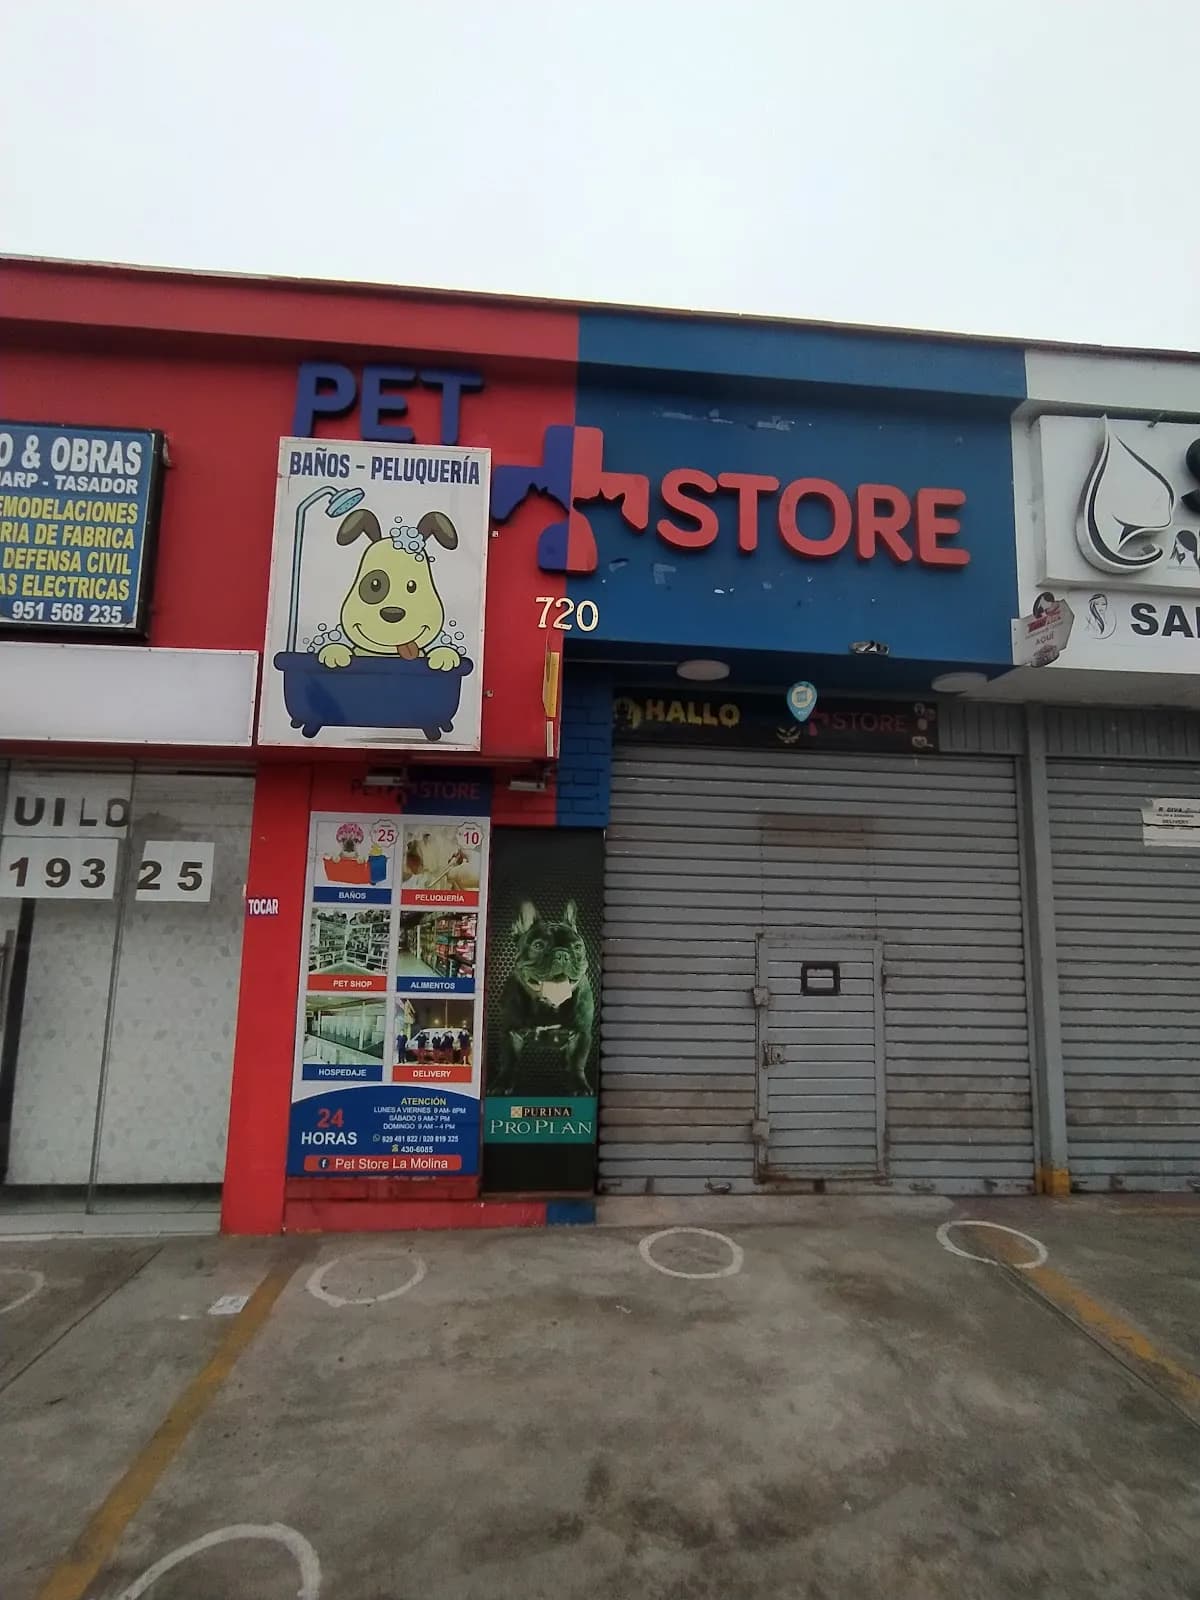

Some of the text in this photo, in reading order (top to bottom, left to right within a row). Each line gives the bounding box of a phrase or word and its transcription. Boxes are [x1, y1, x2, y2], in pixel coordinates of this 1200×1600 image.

[293, 361, 484, 446] PET
[21, 435, 41, 469] &
[50, 437, 142, 475] OBRAS
[290, 447, 350, 478] BAÑOS
[371, 456, 480, 485] PELUQUERÍA
[0, 471, 38, 488] ARP
[54, 475, 138, 494] TASADOR
[656, 468, 971, 566] STORE
[34, 524, 58, 545] DE
[62, 525, 134, 549] FABRICA
[3, 548, 131, 574] DEFENSA CIVIL
[22, 575, 129, 600] ELECTRICAS
[12, 601, 122, 623] 951 568 235
[536, 597, 598, 631] 720
[646, 699, 740, 727] HALLO
[834, 711, 907, 733] STORE
[377, 829, 394, 843] 25
[463, 832, 479, 845] 10
[338, 890, 366, 900] BAÑOS
[415, 893, 464, 902] PELUQUERÍA
[248, 899, 279, 915] TOCAR
[333, 980, 349, 988] PET
[410, 982, 455, 990] ALIMENTOS
[318, 1068, 367, 1077] HOSPEDAJE
[413, 1070, 451, 1078] DELIVERY
[401, 1097, 447, 1106] ATENCIÓN
[317, 1108, 344, 1128] 24
[524, 1108, 570, 1116] PURINA
[301, 1132, 357, 1145] HORAS
[335, 1158, 355, 1169] Pet
[358, 1158, 389, 1169] Store
[393, 1158, 406, 1169] La
[410, 1158, 448, 1169] Molina
